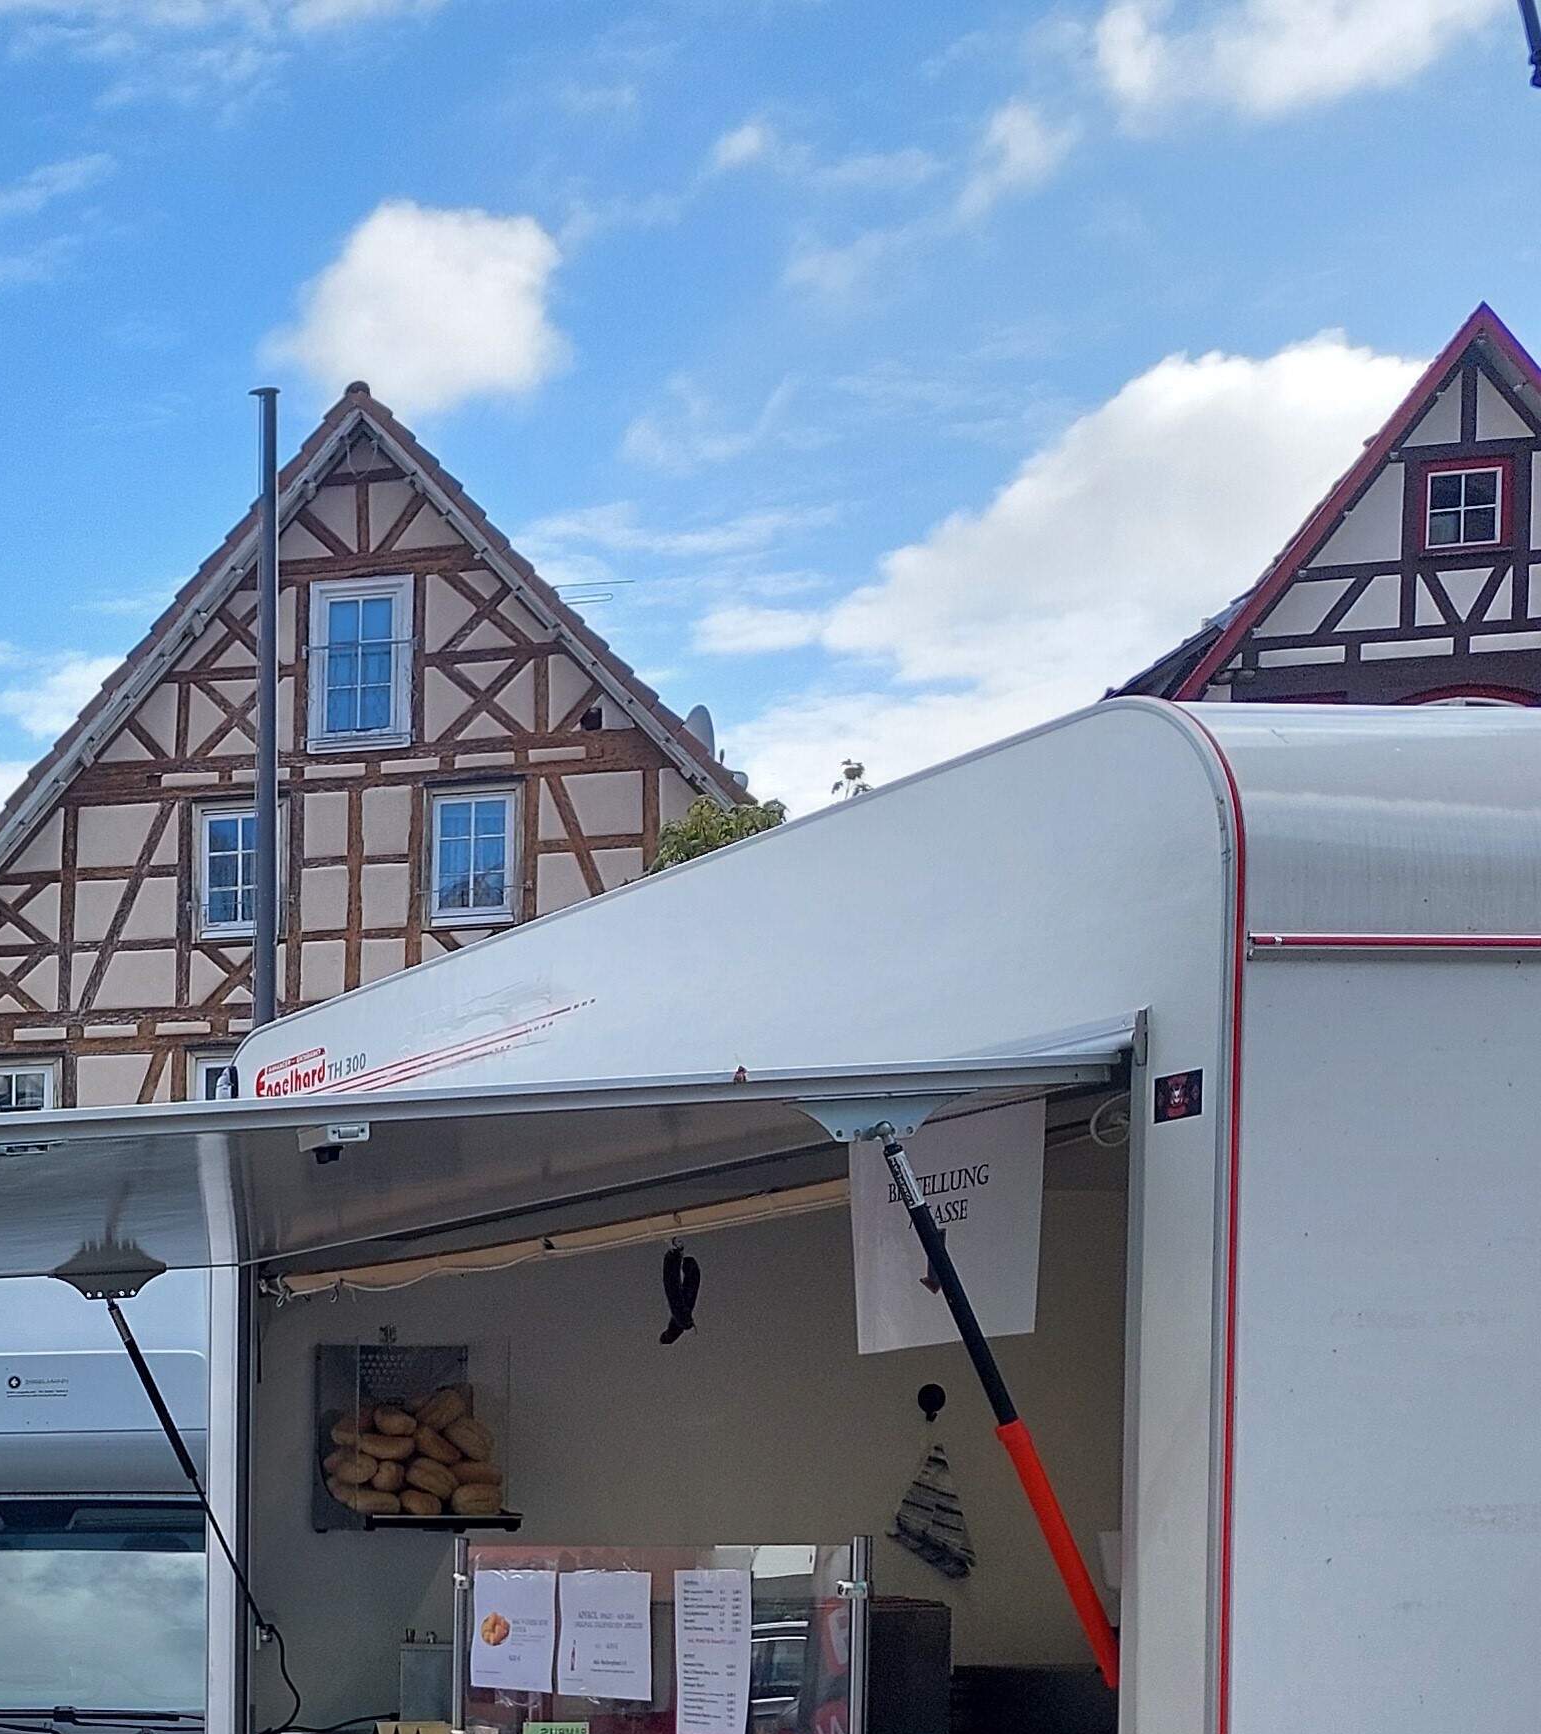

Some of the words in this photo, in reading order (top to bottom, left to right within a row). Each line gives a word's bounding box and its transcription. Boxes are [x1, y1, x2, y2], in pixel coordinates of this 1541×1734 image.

[256, 1059, 325, 1097] Engelhard
[327, 1060, 342, 1080] TH
[345, 1053, 366, 1075] 300
[888, 1164, 989, 1203] BTELLUNG
[925, 1199, 969, 1224] ASSE
